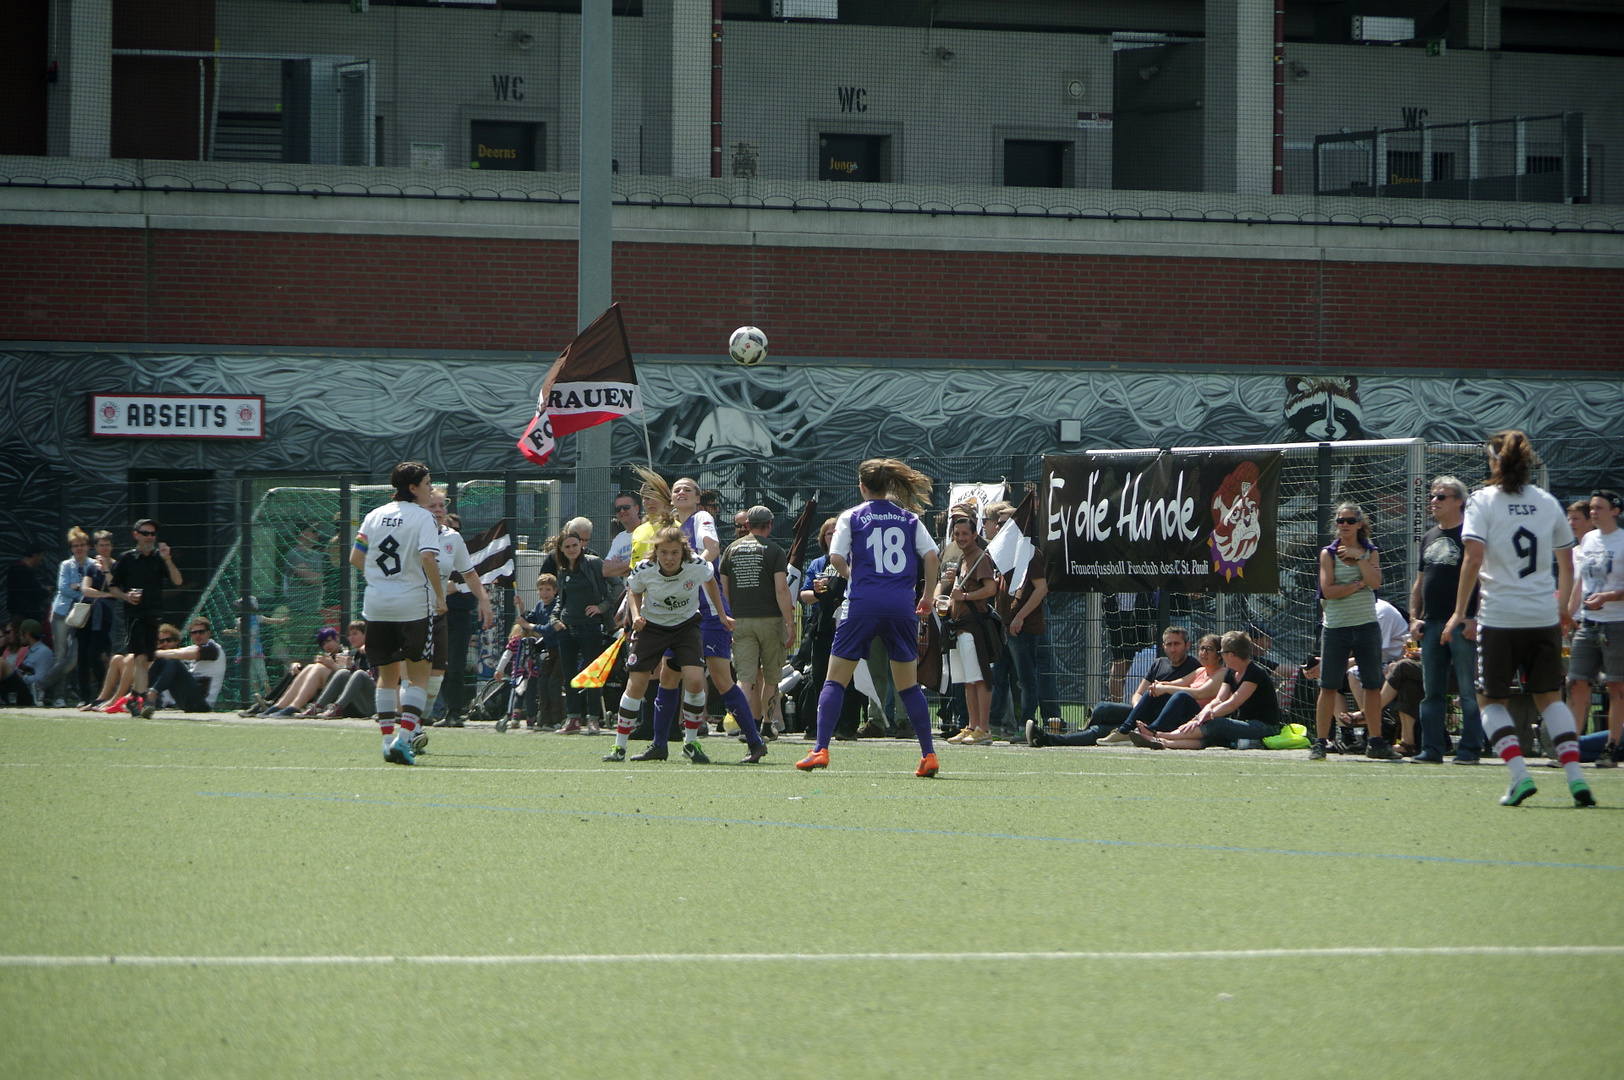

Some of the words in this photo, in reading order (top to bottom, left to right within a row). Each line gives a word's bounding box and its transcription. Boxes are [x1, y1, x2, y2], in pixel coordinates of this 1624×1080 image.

[492, 74, 524, 101] WC
[838, 86, 868, 112] WC
[478, 144, 517, 159] Deerns
[829, 157, 858, 174] Jung
[546, 388, 634, 409] RAUEN
[127, 403, 228, 428] ABSEITS
[381, 517, 403, 527] FCSP
[1047, 470, 1072, 575] Ey
[1075, 469, 1112, 542] die
[1507, 504, 1538, 515] FCSP
[375, 534, 402, 577] 8
[865, 526, 908, 574] 18
[1511, 526, 1538, 579] 9
